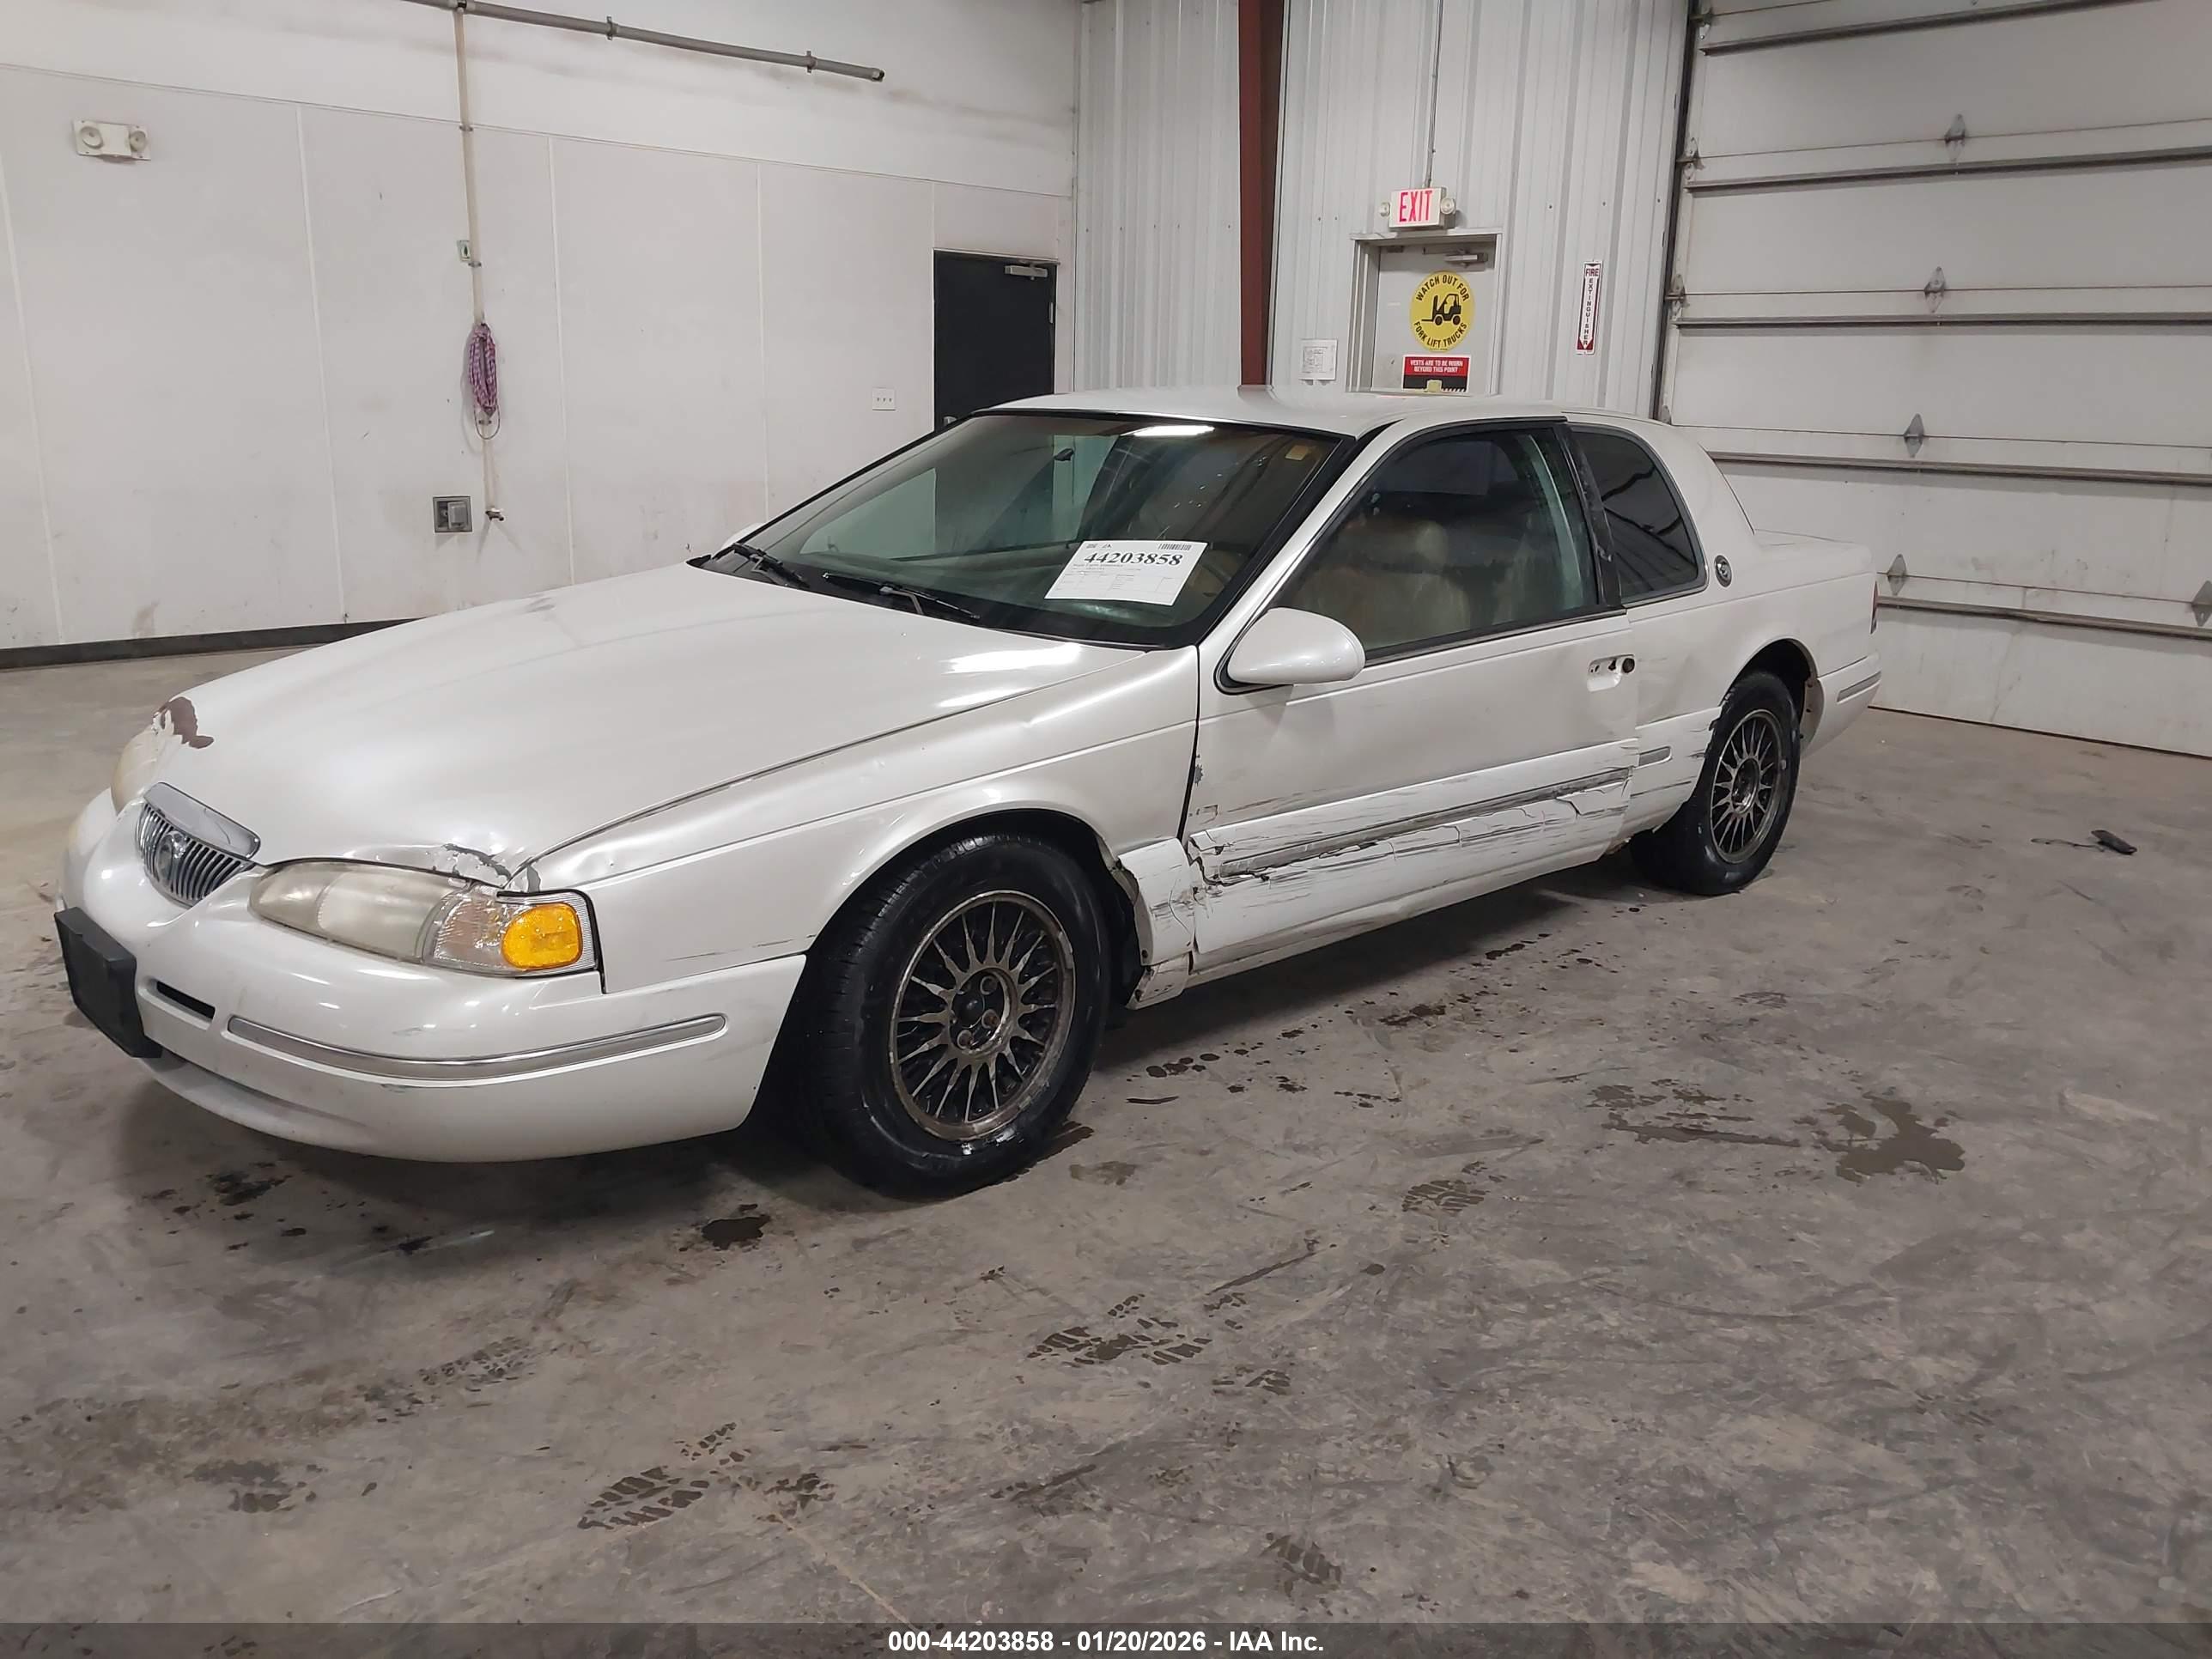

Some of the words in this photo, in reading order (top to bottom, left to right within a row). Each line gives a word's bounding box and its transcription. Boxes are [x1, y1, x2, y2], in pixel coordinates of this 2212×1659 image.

[1399, 190, 1432, 222] EXIT
[1585, 268, 1599, 276] FIRE
[1415, 275, 1440, 301] WATCH
[1443, 274, 1458, 287] OUT
[1456, 283, 1469, 301] FOR
[1583, 277, 1594, 345] EXTINGUISHER
[1413, 321, 1428, 342] FORK
[1426, 337, 1441, 348] LIFT
[1443, 322, 1468, 347] TRUCKS
[1084, 552, 1183, 566] 44203858
